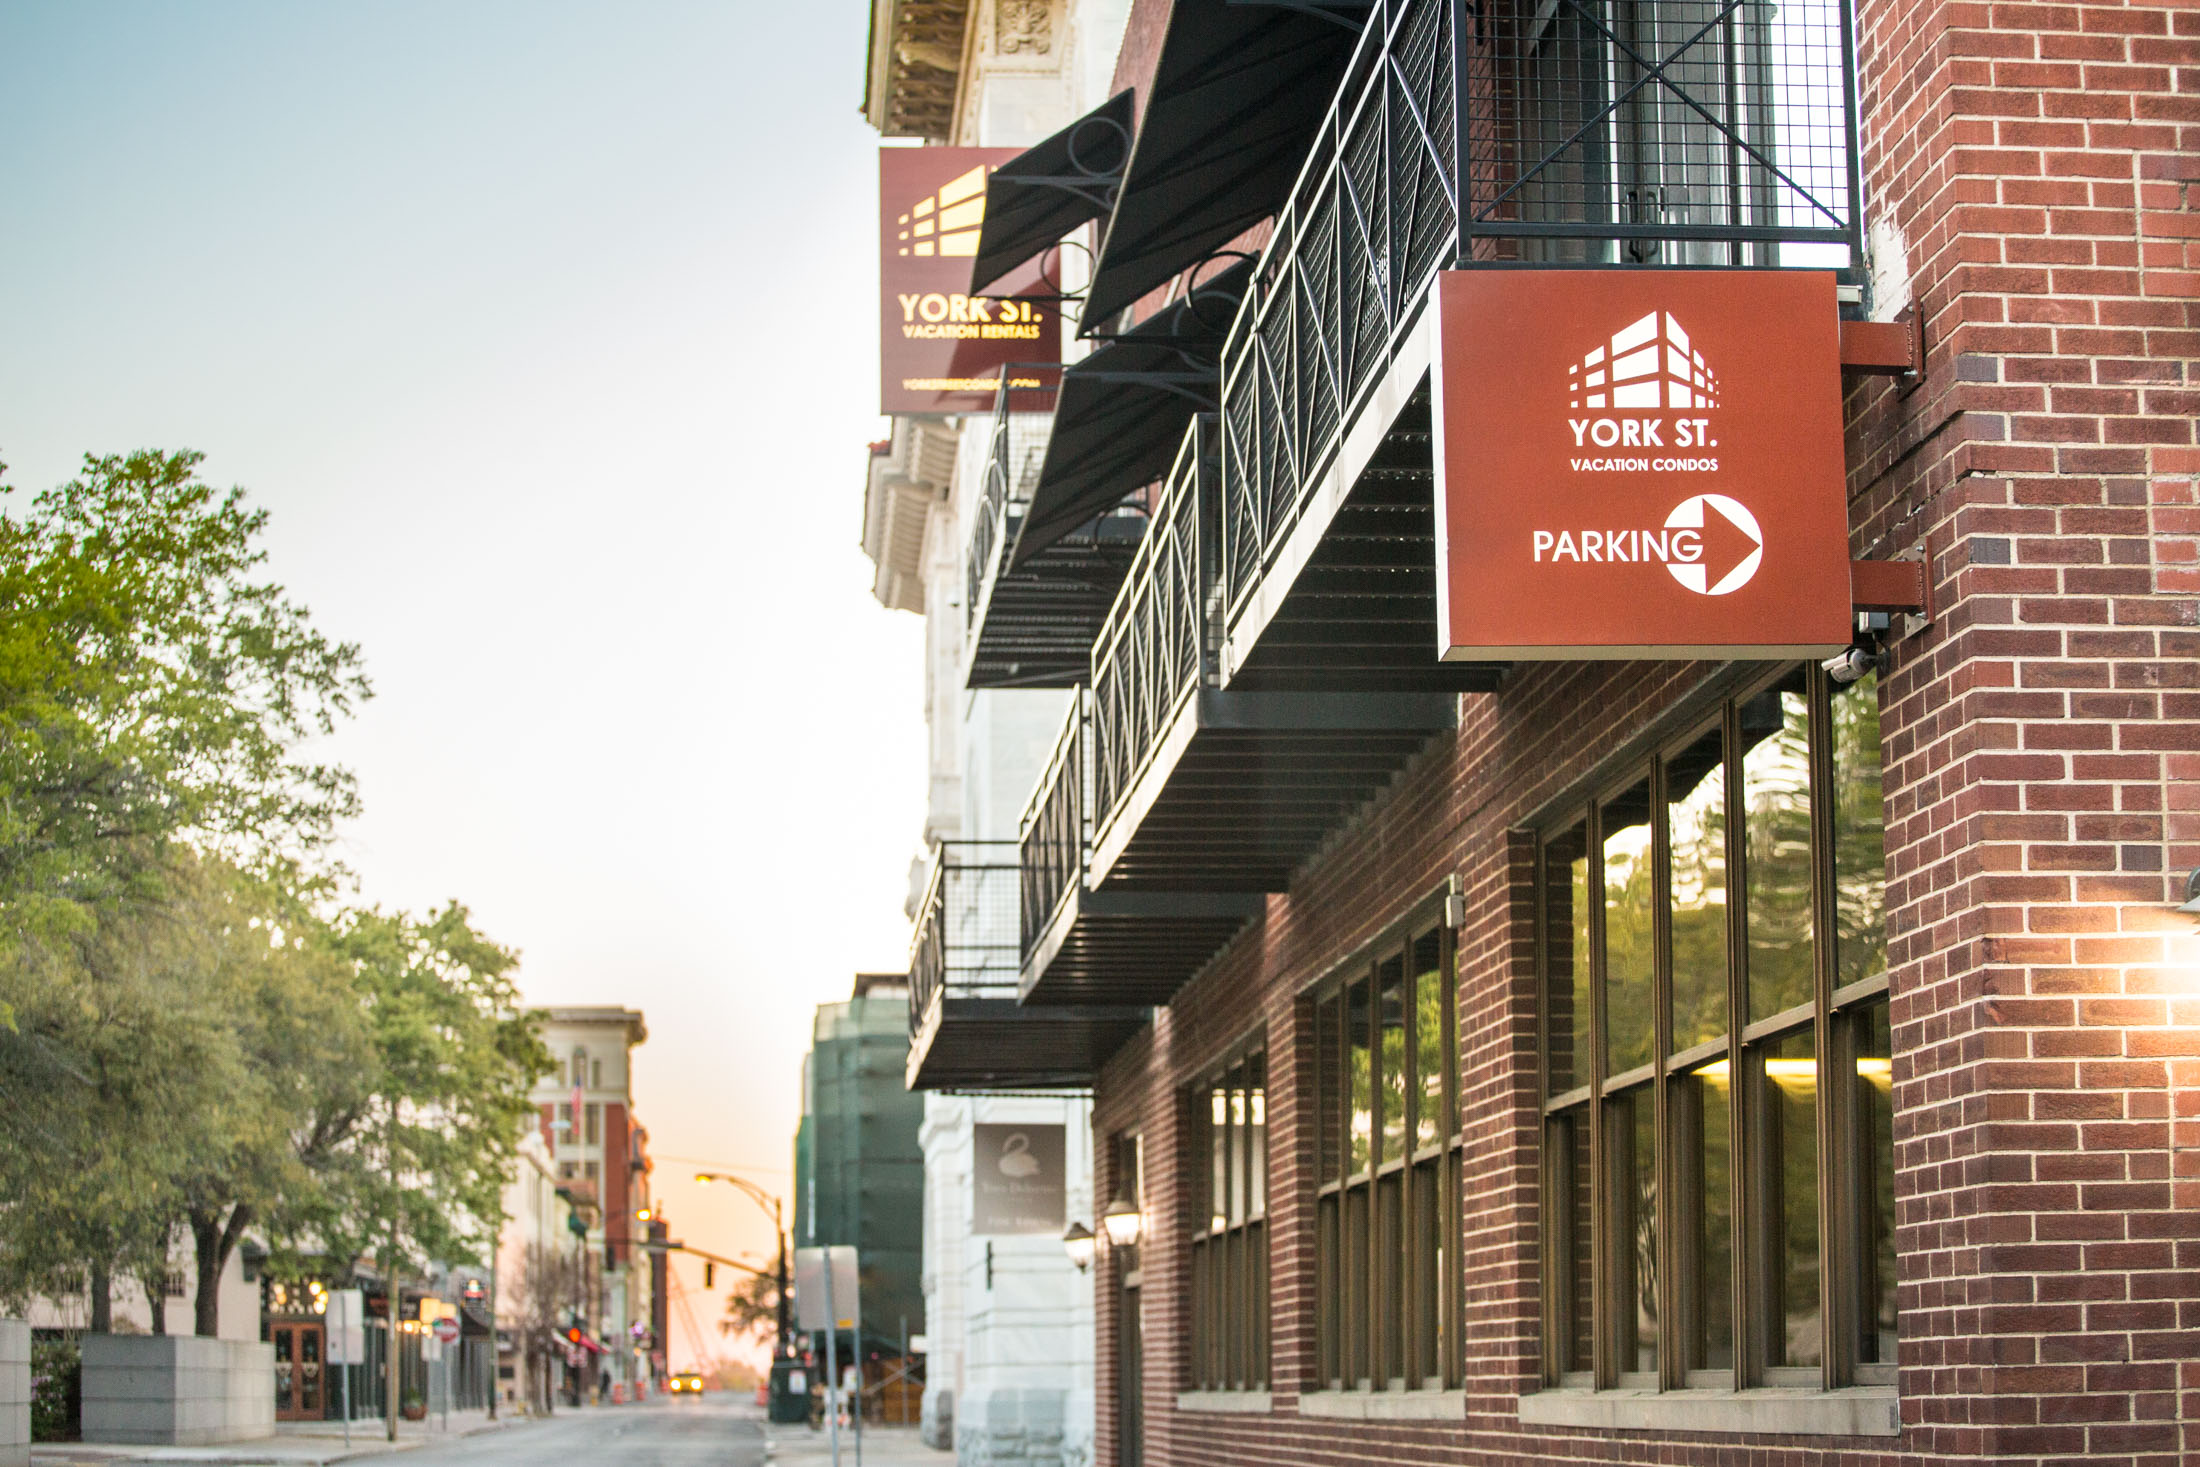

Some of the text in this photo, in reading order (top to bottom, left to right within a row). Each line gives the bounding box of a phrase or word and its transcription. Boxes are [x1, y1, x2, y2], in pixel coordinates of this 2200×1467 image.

[898, 293, 992, 322] YORK
[902, 324, 1040, 339] VACATION RENTALS
[1568, 418, 1718, 447] YORK ST.
[1570, 458, 1719, 471] VACATION CONDOS
[1533, 530, 1704, 562] PARKING
